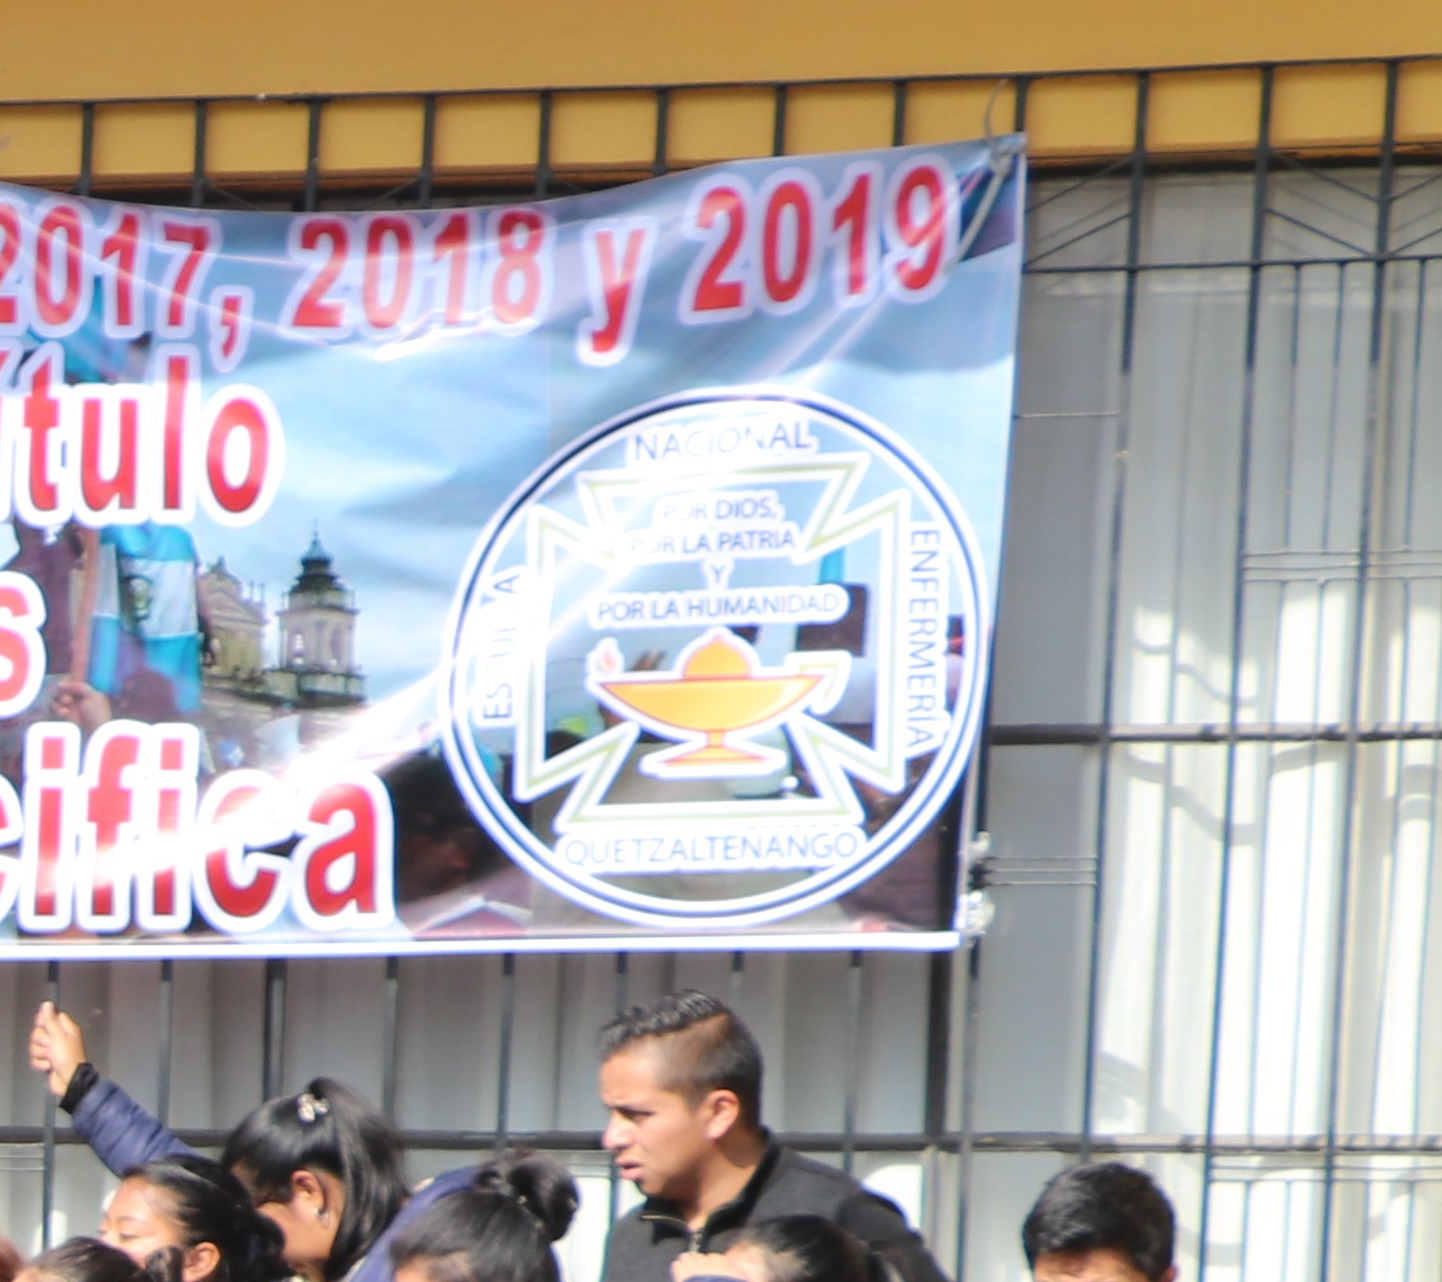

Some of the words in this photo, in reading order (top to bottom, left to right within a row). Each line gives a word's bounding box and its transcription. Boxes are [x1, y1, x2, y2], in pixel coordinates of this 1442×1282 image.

[294, 212, 542, 327] 2018
[593, 233, 640, 353] y
[694, 167, 944, 311] 2019
[632, 419, 812, 461] NACIONAL
[681, 534, 711, 554] LA
[718, 530, 795, 550] PATRIA
[709, 564, 727, 583] Y
[598, 602, 645, 620] POR
[652, 602, 679, 618] LA
[688, 593, 840, 617] HUMANIDAD
[906, 526, 941, 750] ENFERMERÍA
[565, 831, 860, 866] QUETZALTENANGO
